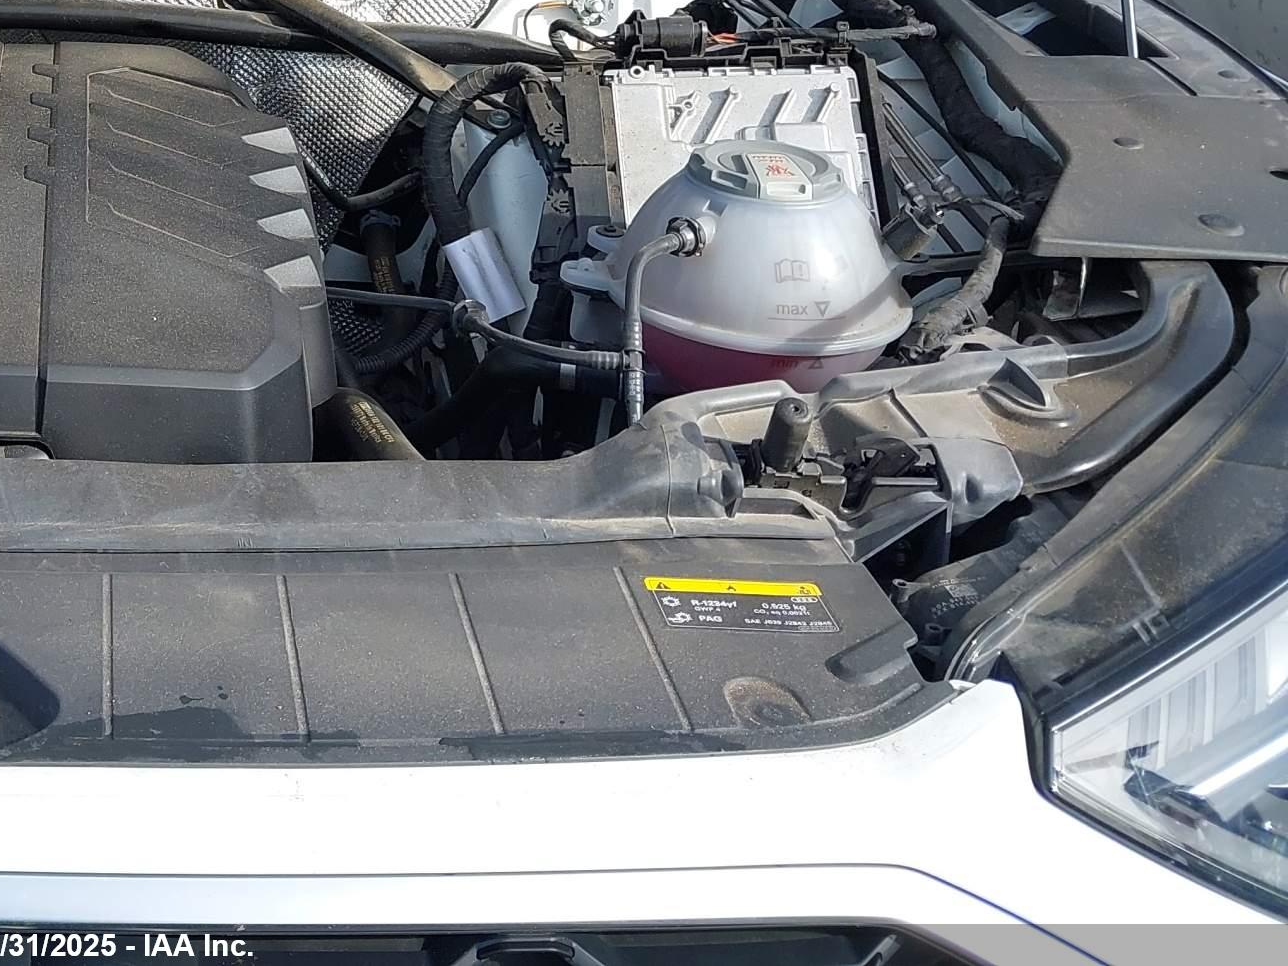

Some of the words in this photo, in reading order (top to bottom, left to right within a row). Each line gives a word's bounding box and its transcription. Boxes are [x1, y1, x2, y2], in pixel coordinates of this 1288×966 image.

[776, 304, 808, 315] max
[691, 599, 737, 609] R-1234yf
[793, 604, 807, 612] kg
[699, 615, 723, 623] PAG
